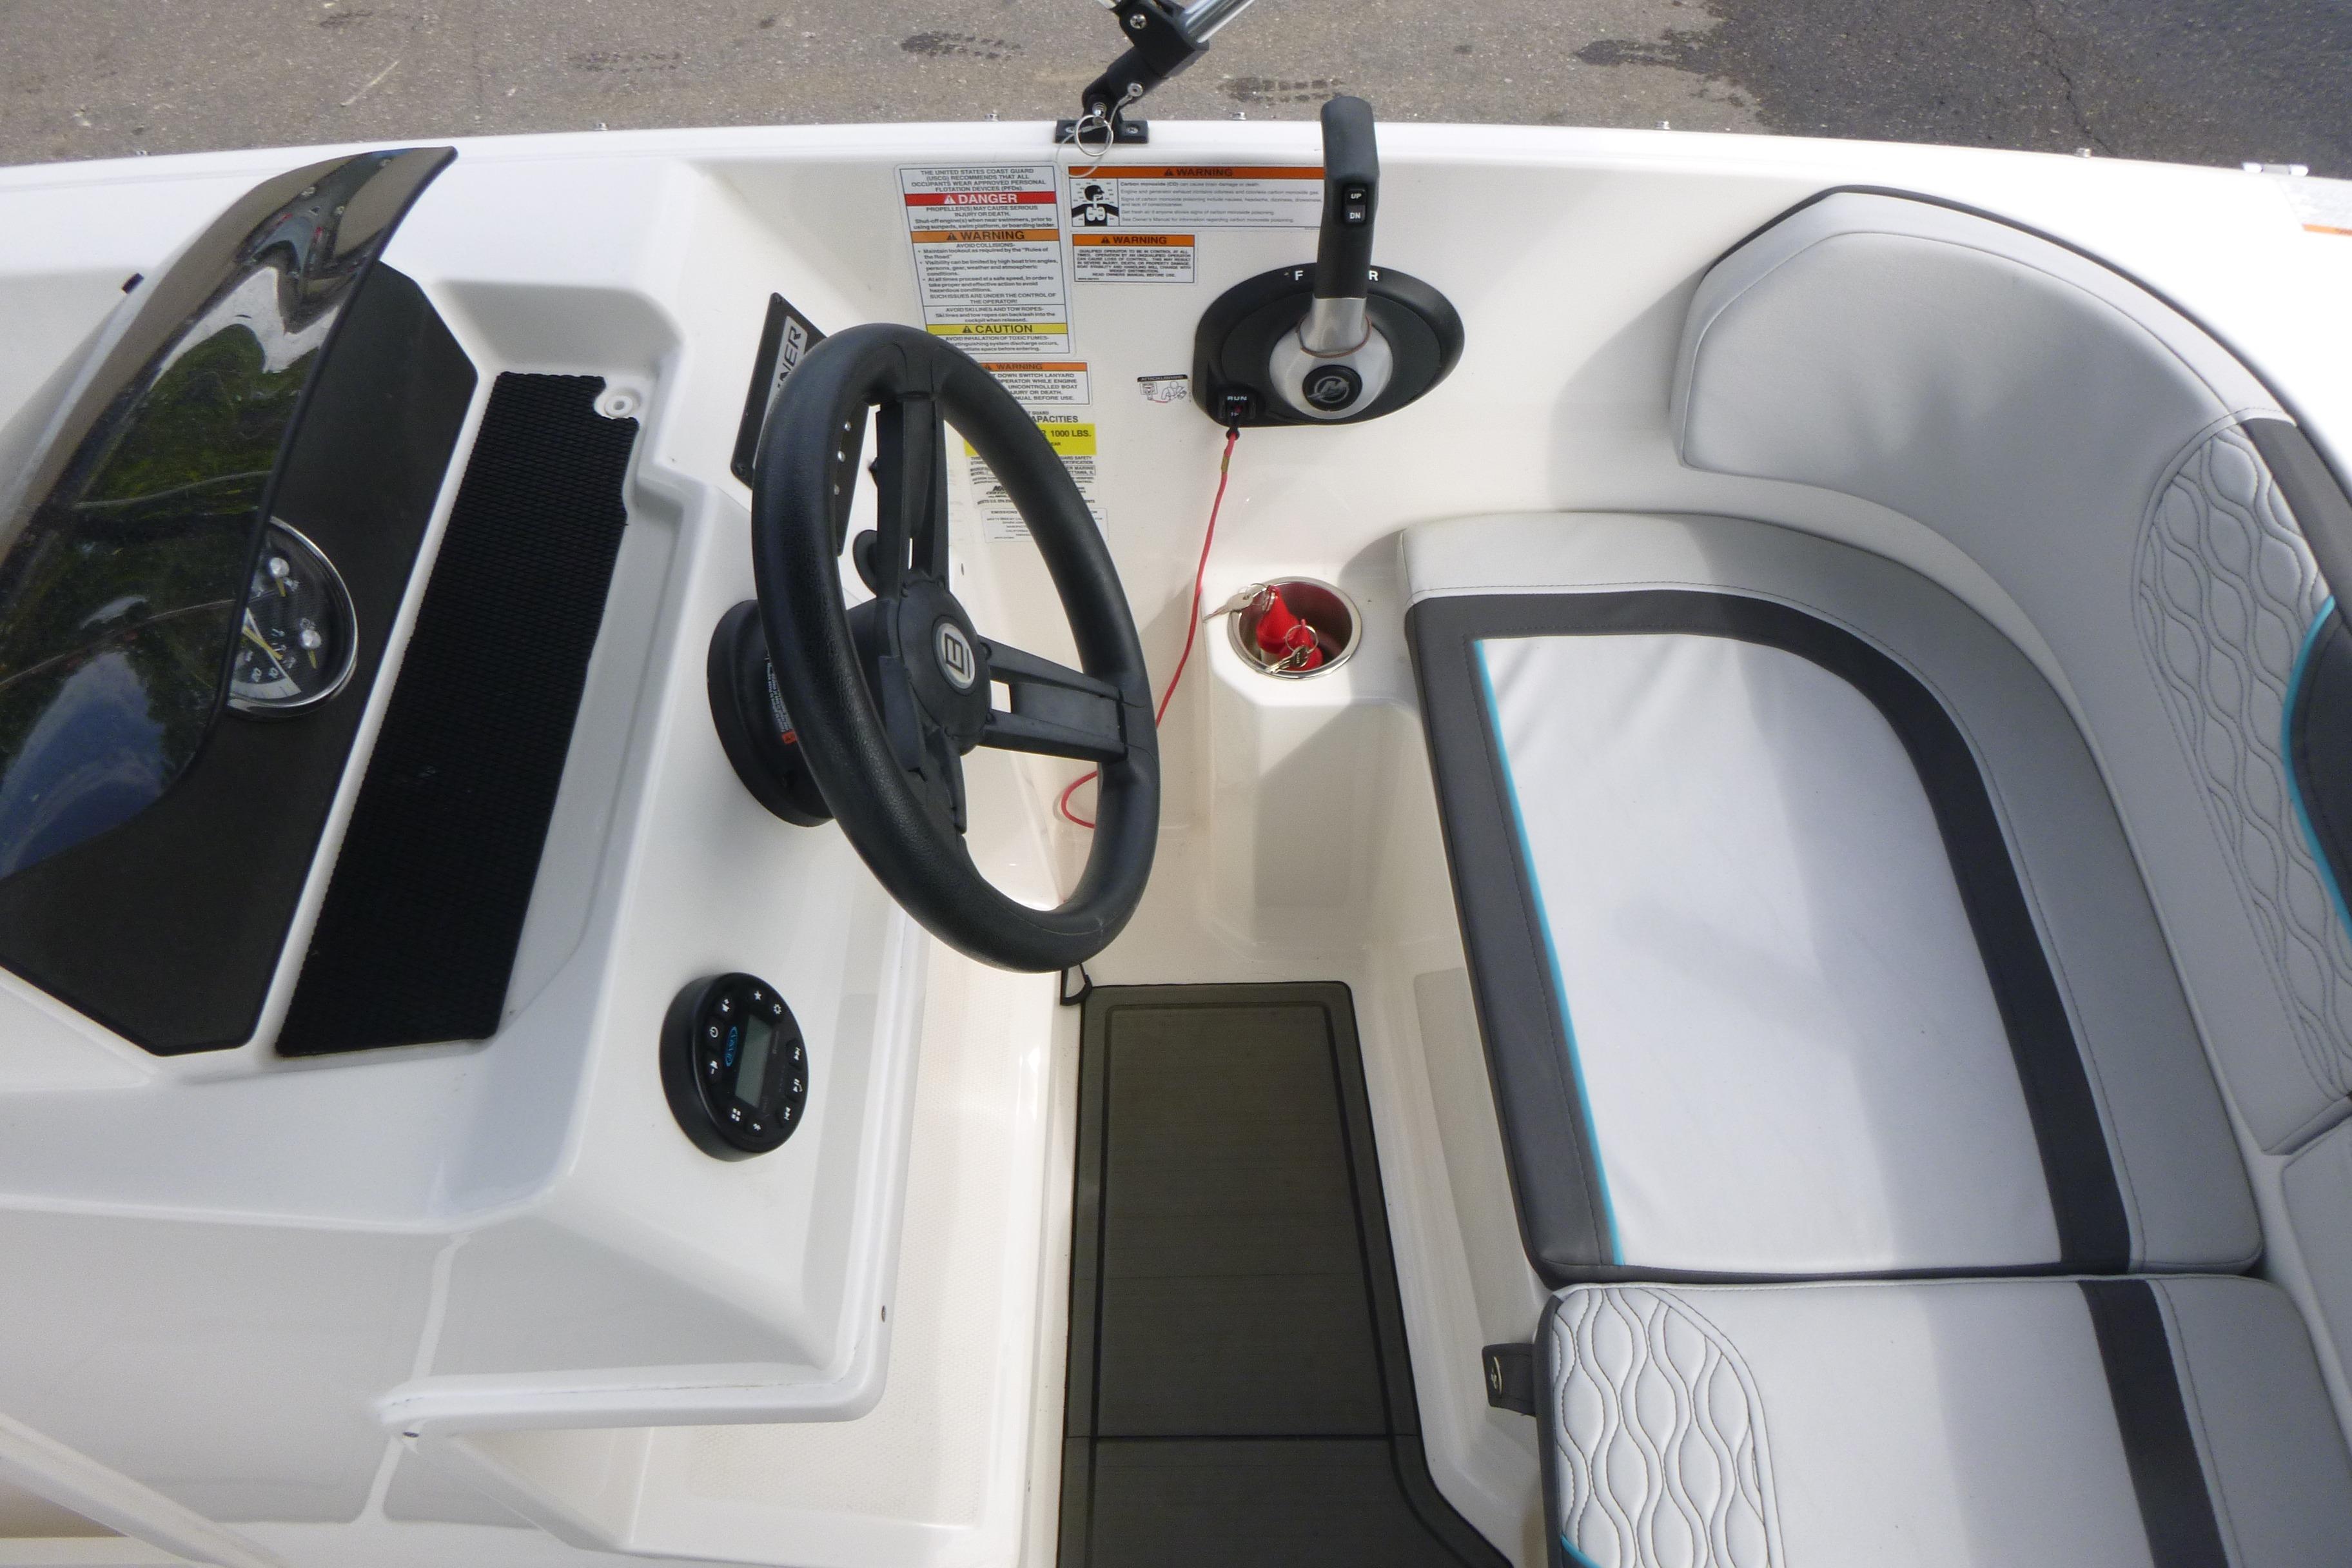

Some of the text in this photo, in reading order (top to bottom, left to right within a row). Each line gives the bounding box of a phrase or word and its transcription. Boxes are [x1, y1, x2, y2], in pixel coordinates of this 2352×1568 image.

[1177, 168, 1233, 177] WARNING
[958, 194, 1017, 204] DANGER
[961, 231, 1024, 240] WARNING
[1295, 270, 1378, 281] F R
[975, 324, 1033, 333] CAUTION
